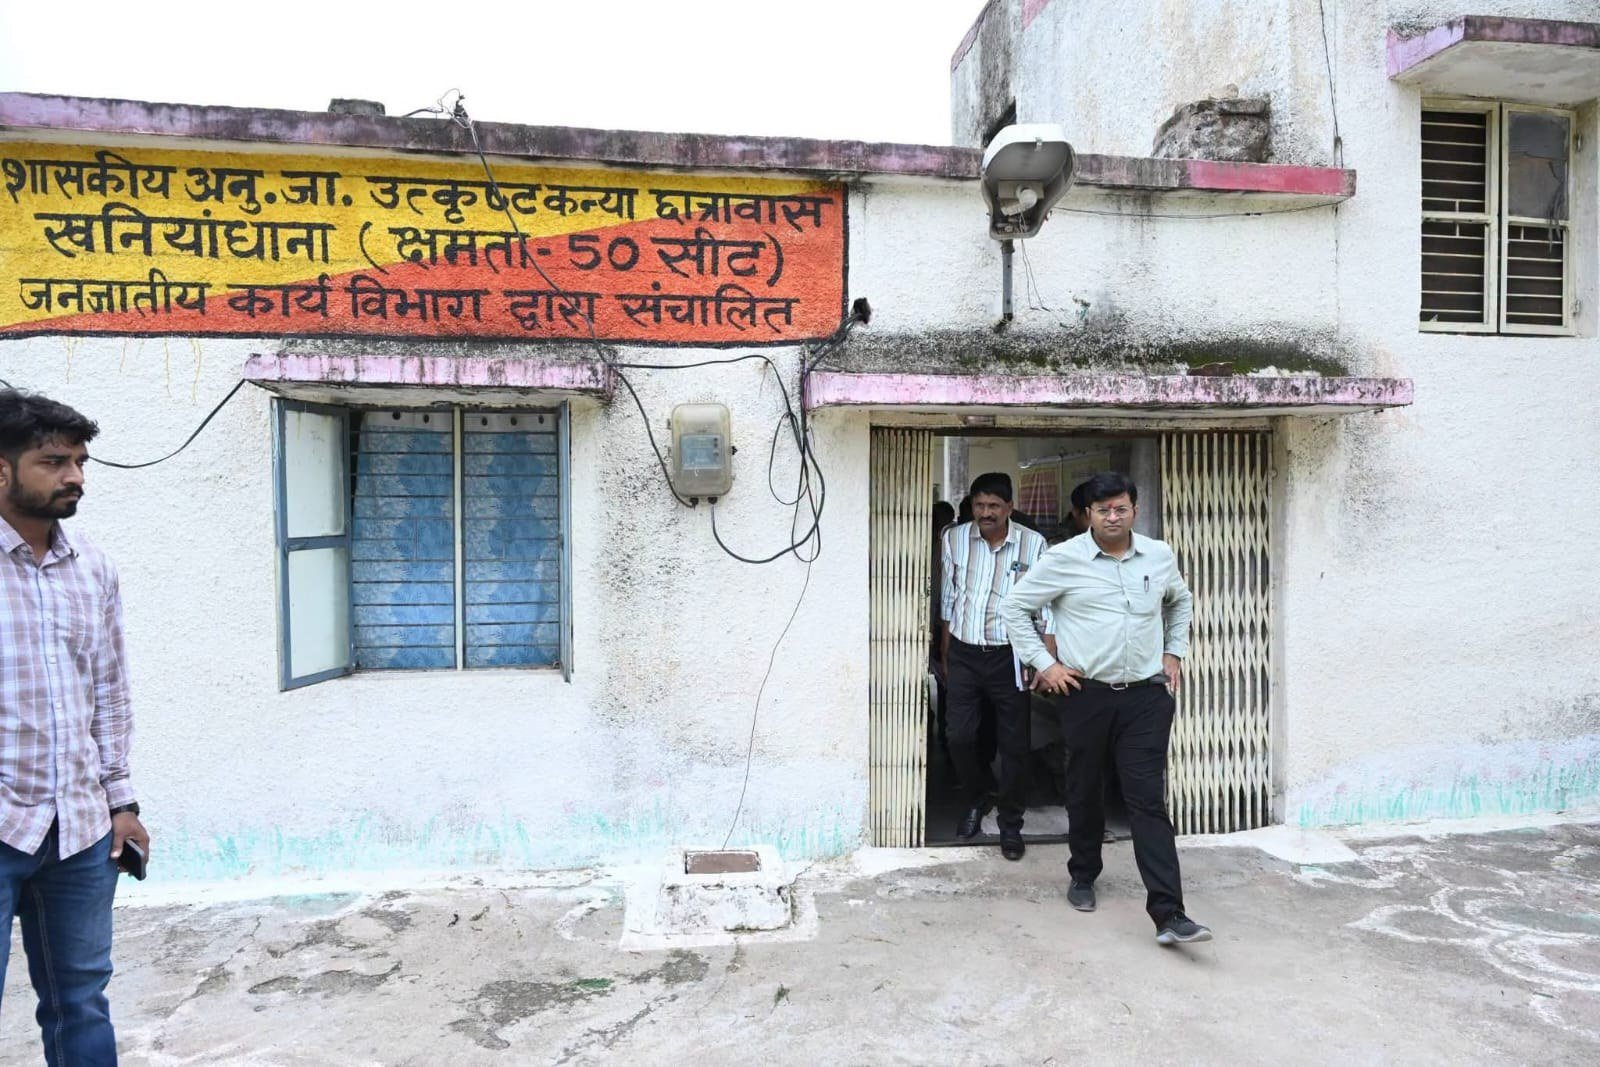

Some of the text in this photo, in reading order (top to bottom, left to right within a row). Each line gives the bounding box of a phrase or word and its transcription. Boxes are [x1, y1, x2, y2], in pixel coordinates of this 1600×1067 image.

[2, 151, 177, 203] शासकीय
[543, 184, 639, 219] कन्या
[648, 189, 834, 232] छात्रावास
[34, 202, 336, 264] खनियांधाना
[567, 234, 640, 272] 50
[650, 227, 784, 287] सीट)
[19, 268, 800, 333] जनजातीय कार्य विभाग द्वारा संचालित
